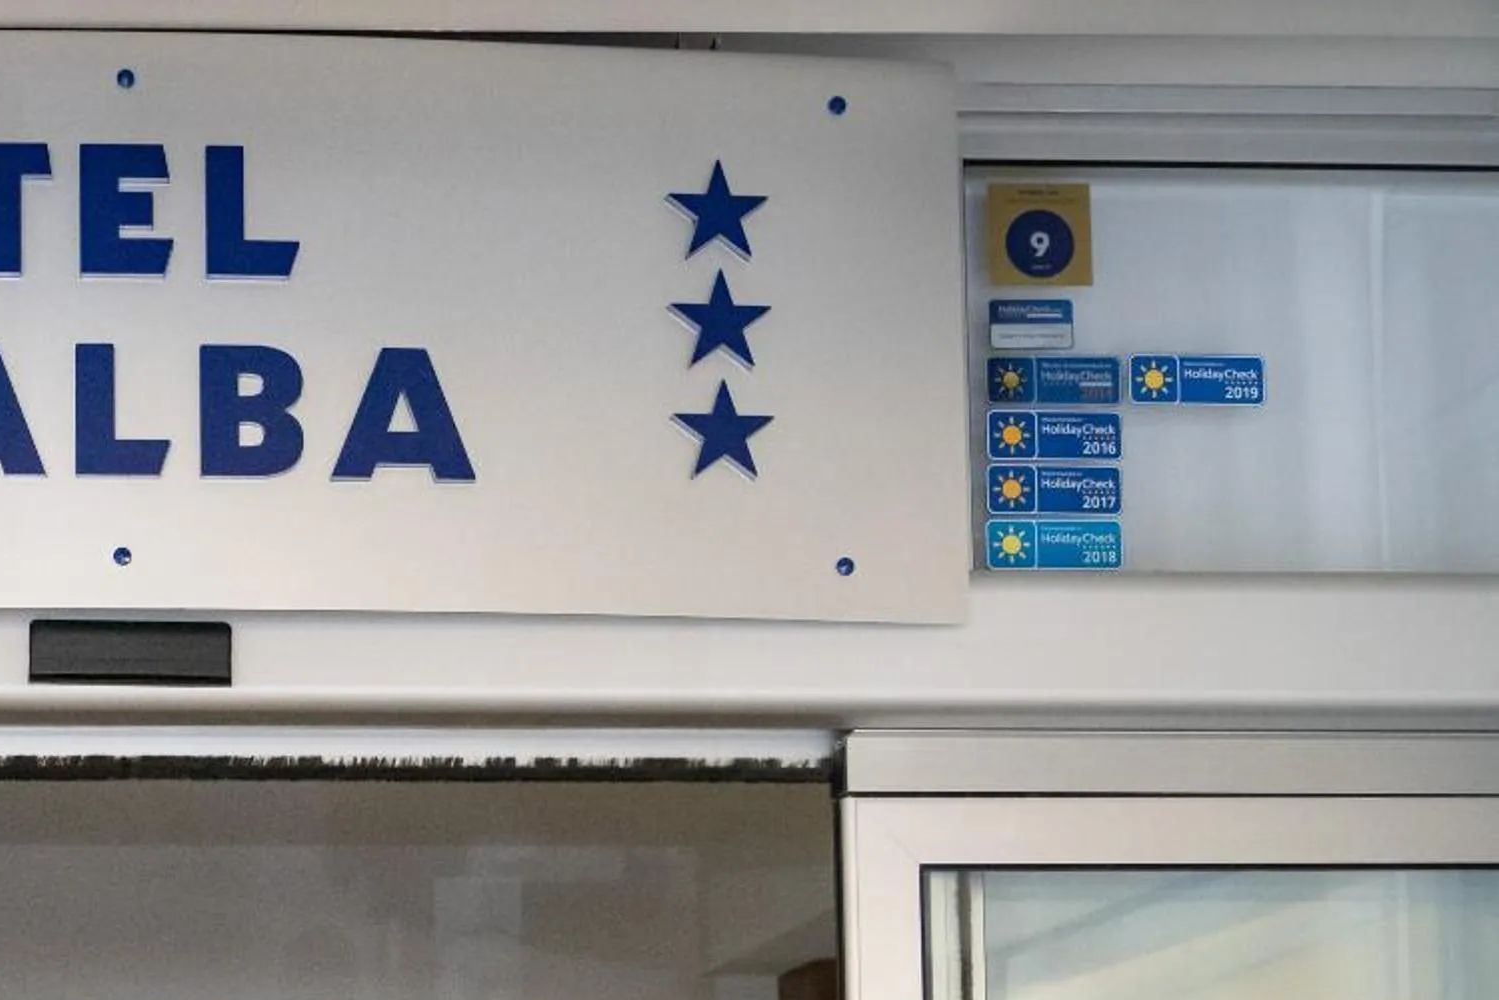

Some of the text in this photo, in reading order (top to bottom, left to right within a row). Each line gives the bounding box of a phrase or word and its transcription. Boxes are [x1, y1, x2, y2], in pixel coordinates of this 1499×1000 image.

[1030, 231, 1051, 257] 9
[1184, 369, 1258, 382] HolidayCheck
[1224, 386, 1259, 399] 2019
[1041, 423, 1116, 438] HolidayCheck
[1082, 441, 1117, 455] 2016
[1041, 478, 1116, 493] HolidayCheck
[1082, 495, 1117, 509] 2017
[1041, 533, 1116, 548] HolidayCheck
[1082, 551, 1118, 564] 2018
